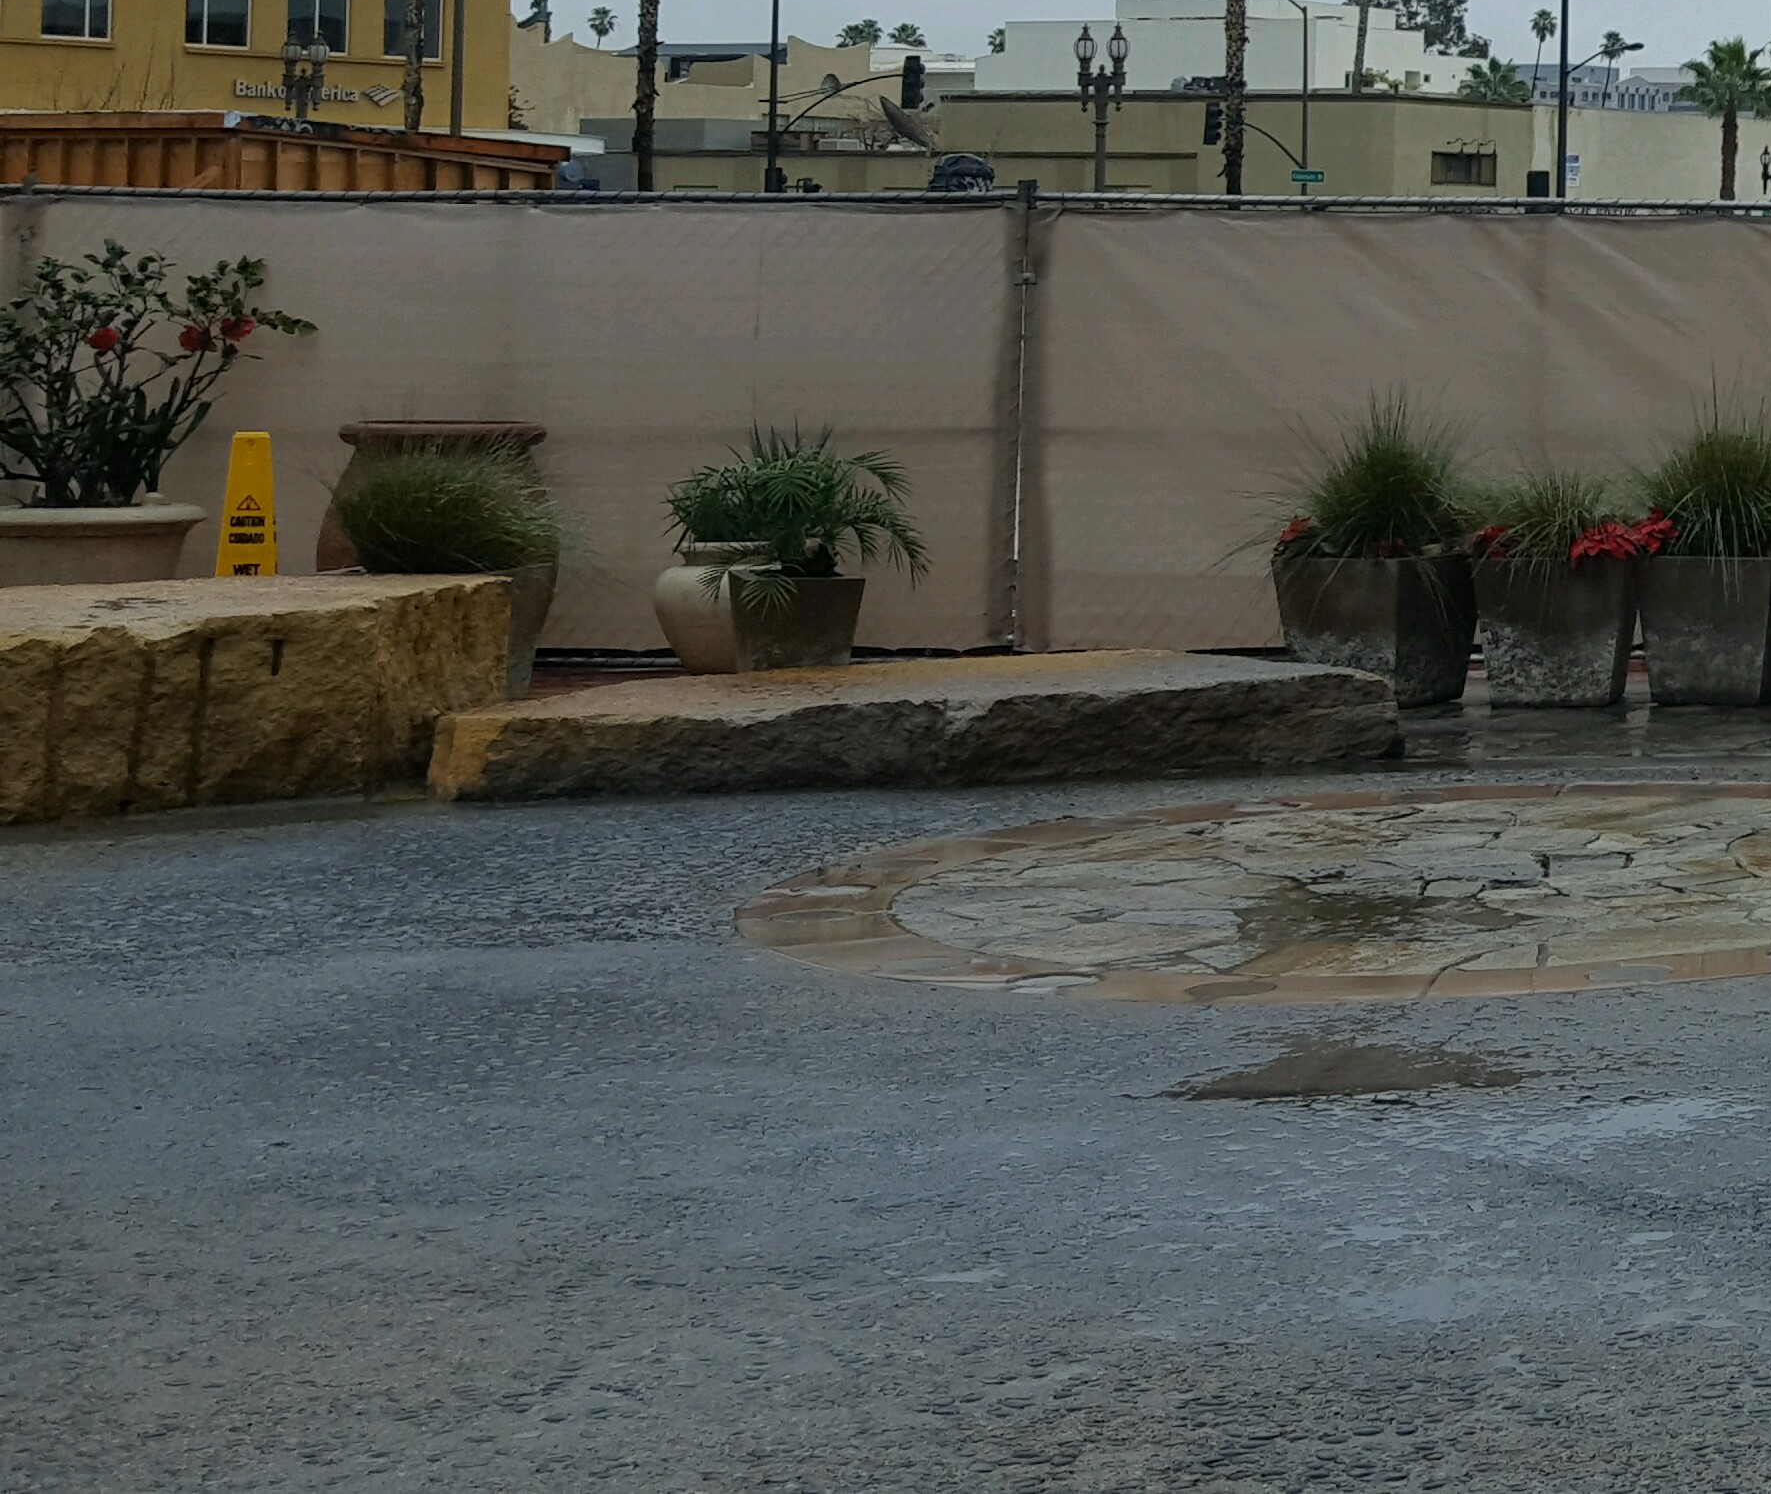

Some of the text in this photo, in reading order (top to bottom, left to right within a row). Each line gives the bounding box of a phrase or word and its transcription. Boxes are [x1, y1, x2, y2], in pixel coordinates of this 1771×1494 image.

[235, 78, 276, 98] Bank
[307, 84, 360, 103] erica
[230, 516, 266, 527] CAUTION
[232, 563, 261, 575] WET
